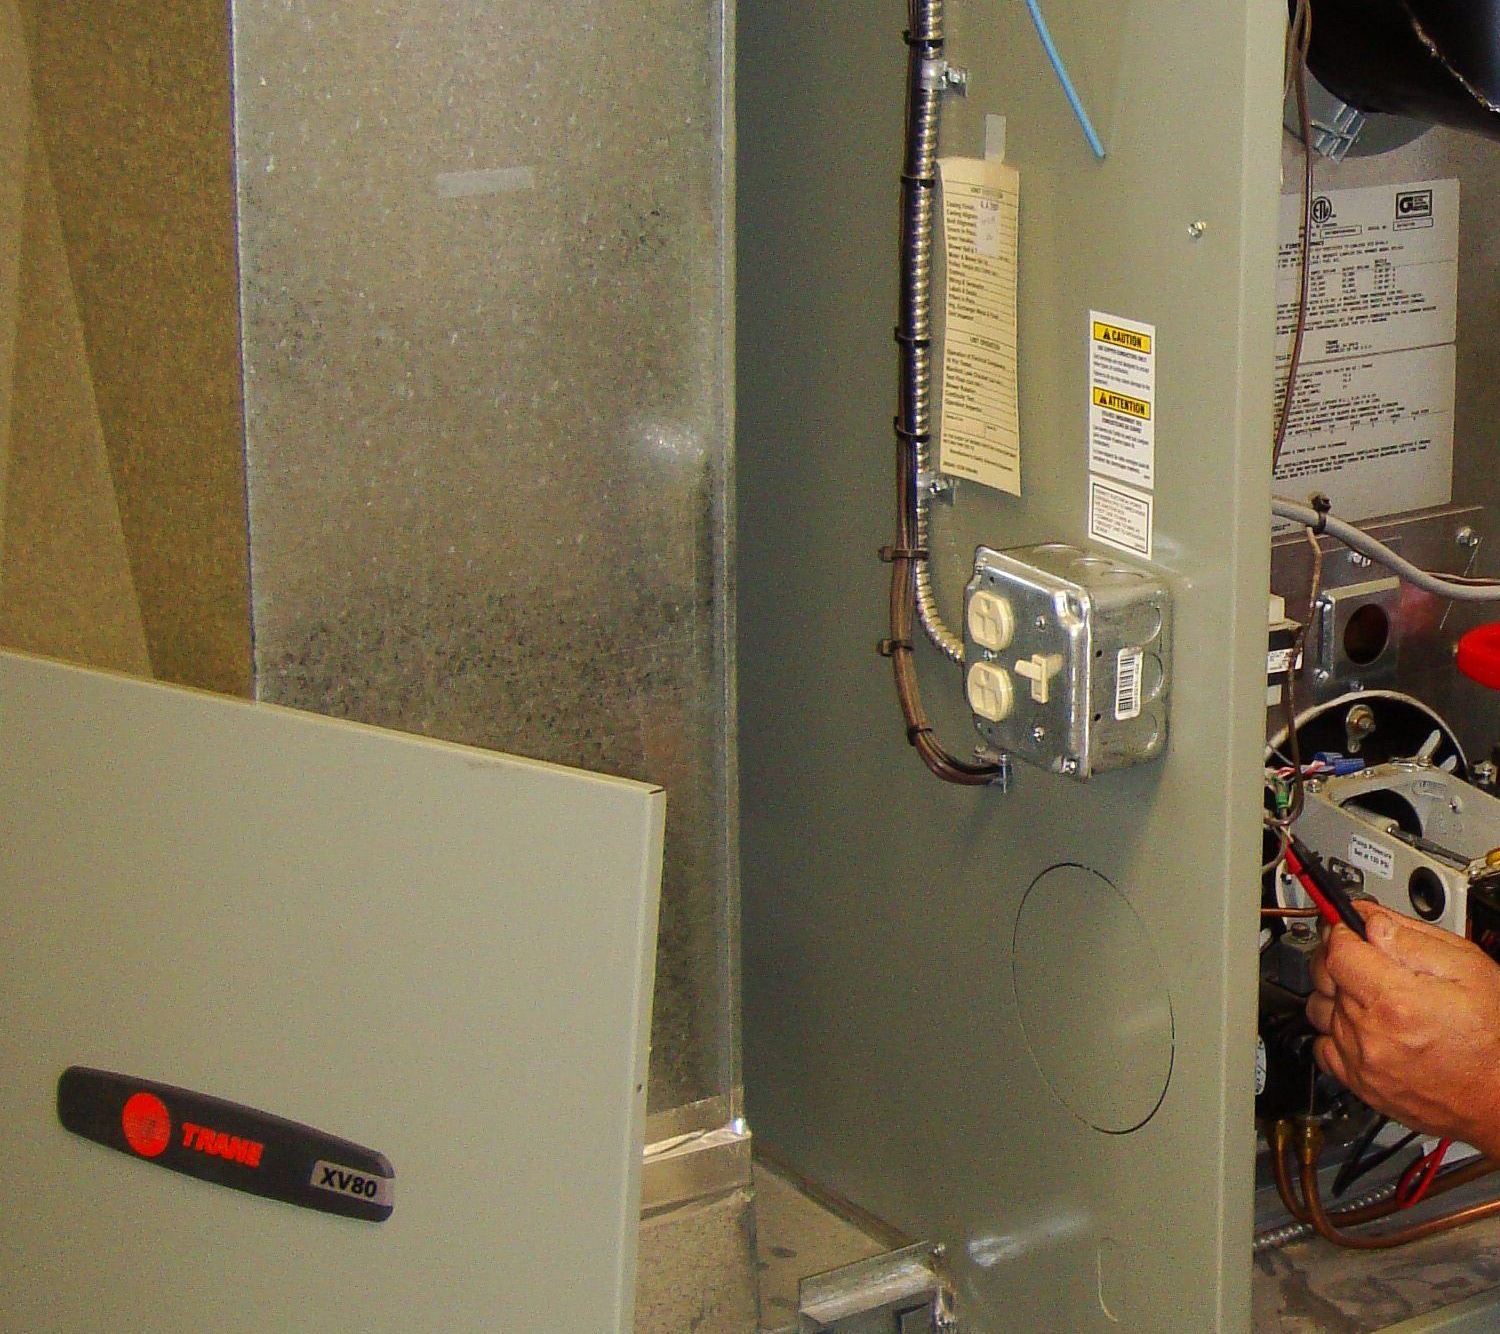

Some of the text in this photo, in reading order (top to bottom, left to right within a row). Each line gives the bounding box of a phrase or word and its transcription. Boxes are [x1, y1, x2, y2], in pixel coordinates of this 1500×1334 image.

[1112, 330, 1142, 348] CAUTION
[1108, 394, 1145, 416] ATTENTION
[182, 1122, 378, 1198] TRANE XV80
